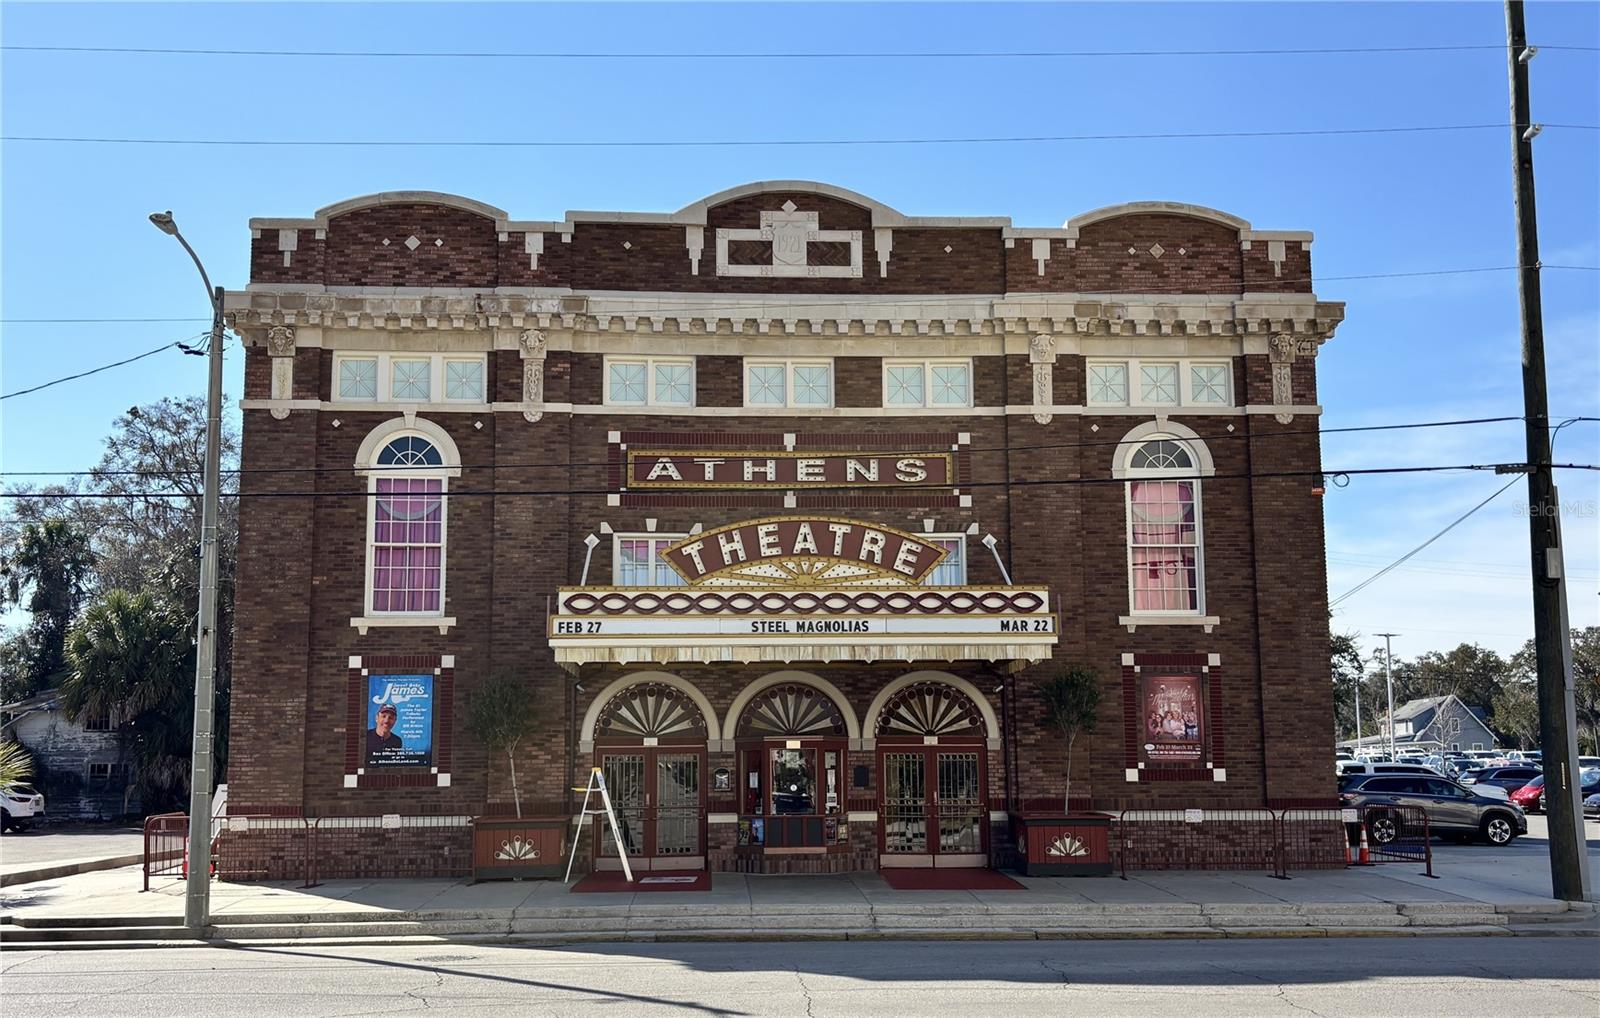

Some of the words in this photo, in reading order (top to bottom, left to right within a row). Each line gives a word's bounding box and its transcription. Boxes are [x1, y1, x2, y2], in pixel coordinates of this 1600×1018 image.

[646, 457, 928, 482] ATHENS
[681, 522, 923, 576] THEATRE
[558, 622, 582, 634] FEB
[587, 622, 602, 634] 27
[751, 621, 790, 633] STEEL
[796, 620, 869, 633] MAGNOLIAS
[1000, 620, 1029, 632] MAR
[1033, 620, 1048, 632] 22
[372, 682, 425, 705] James
